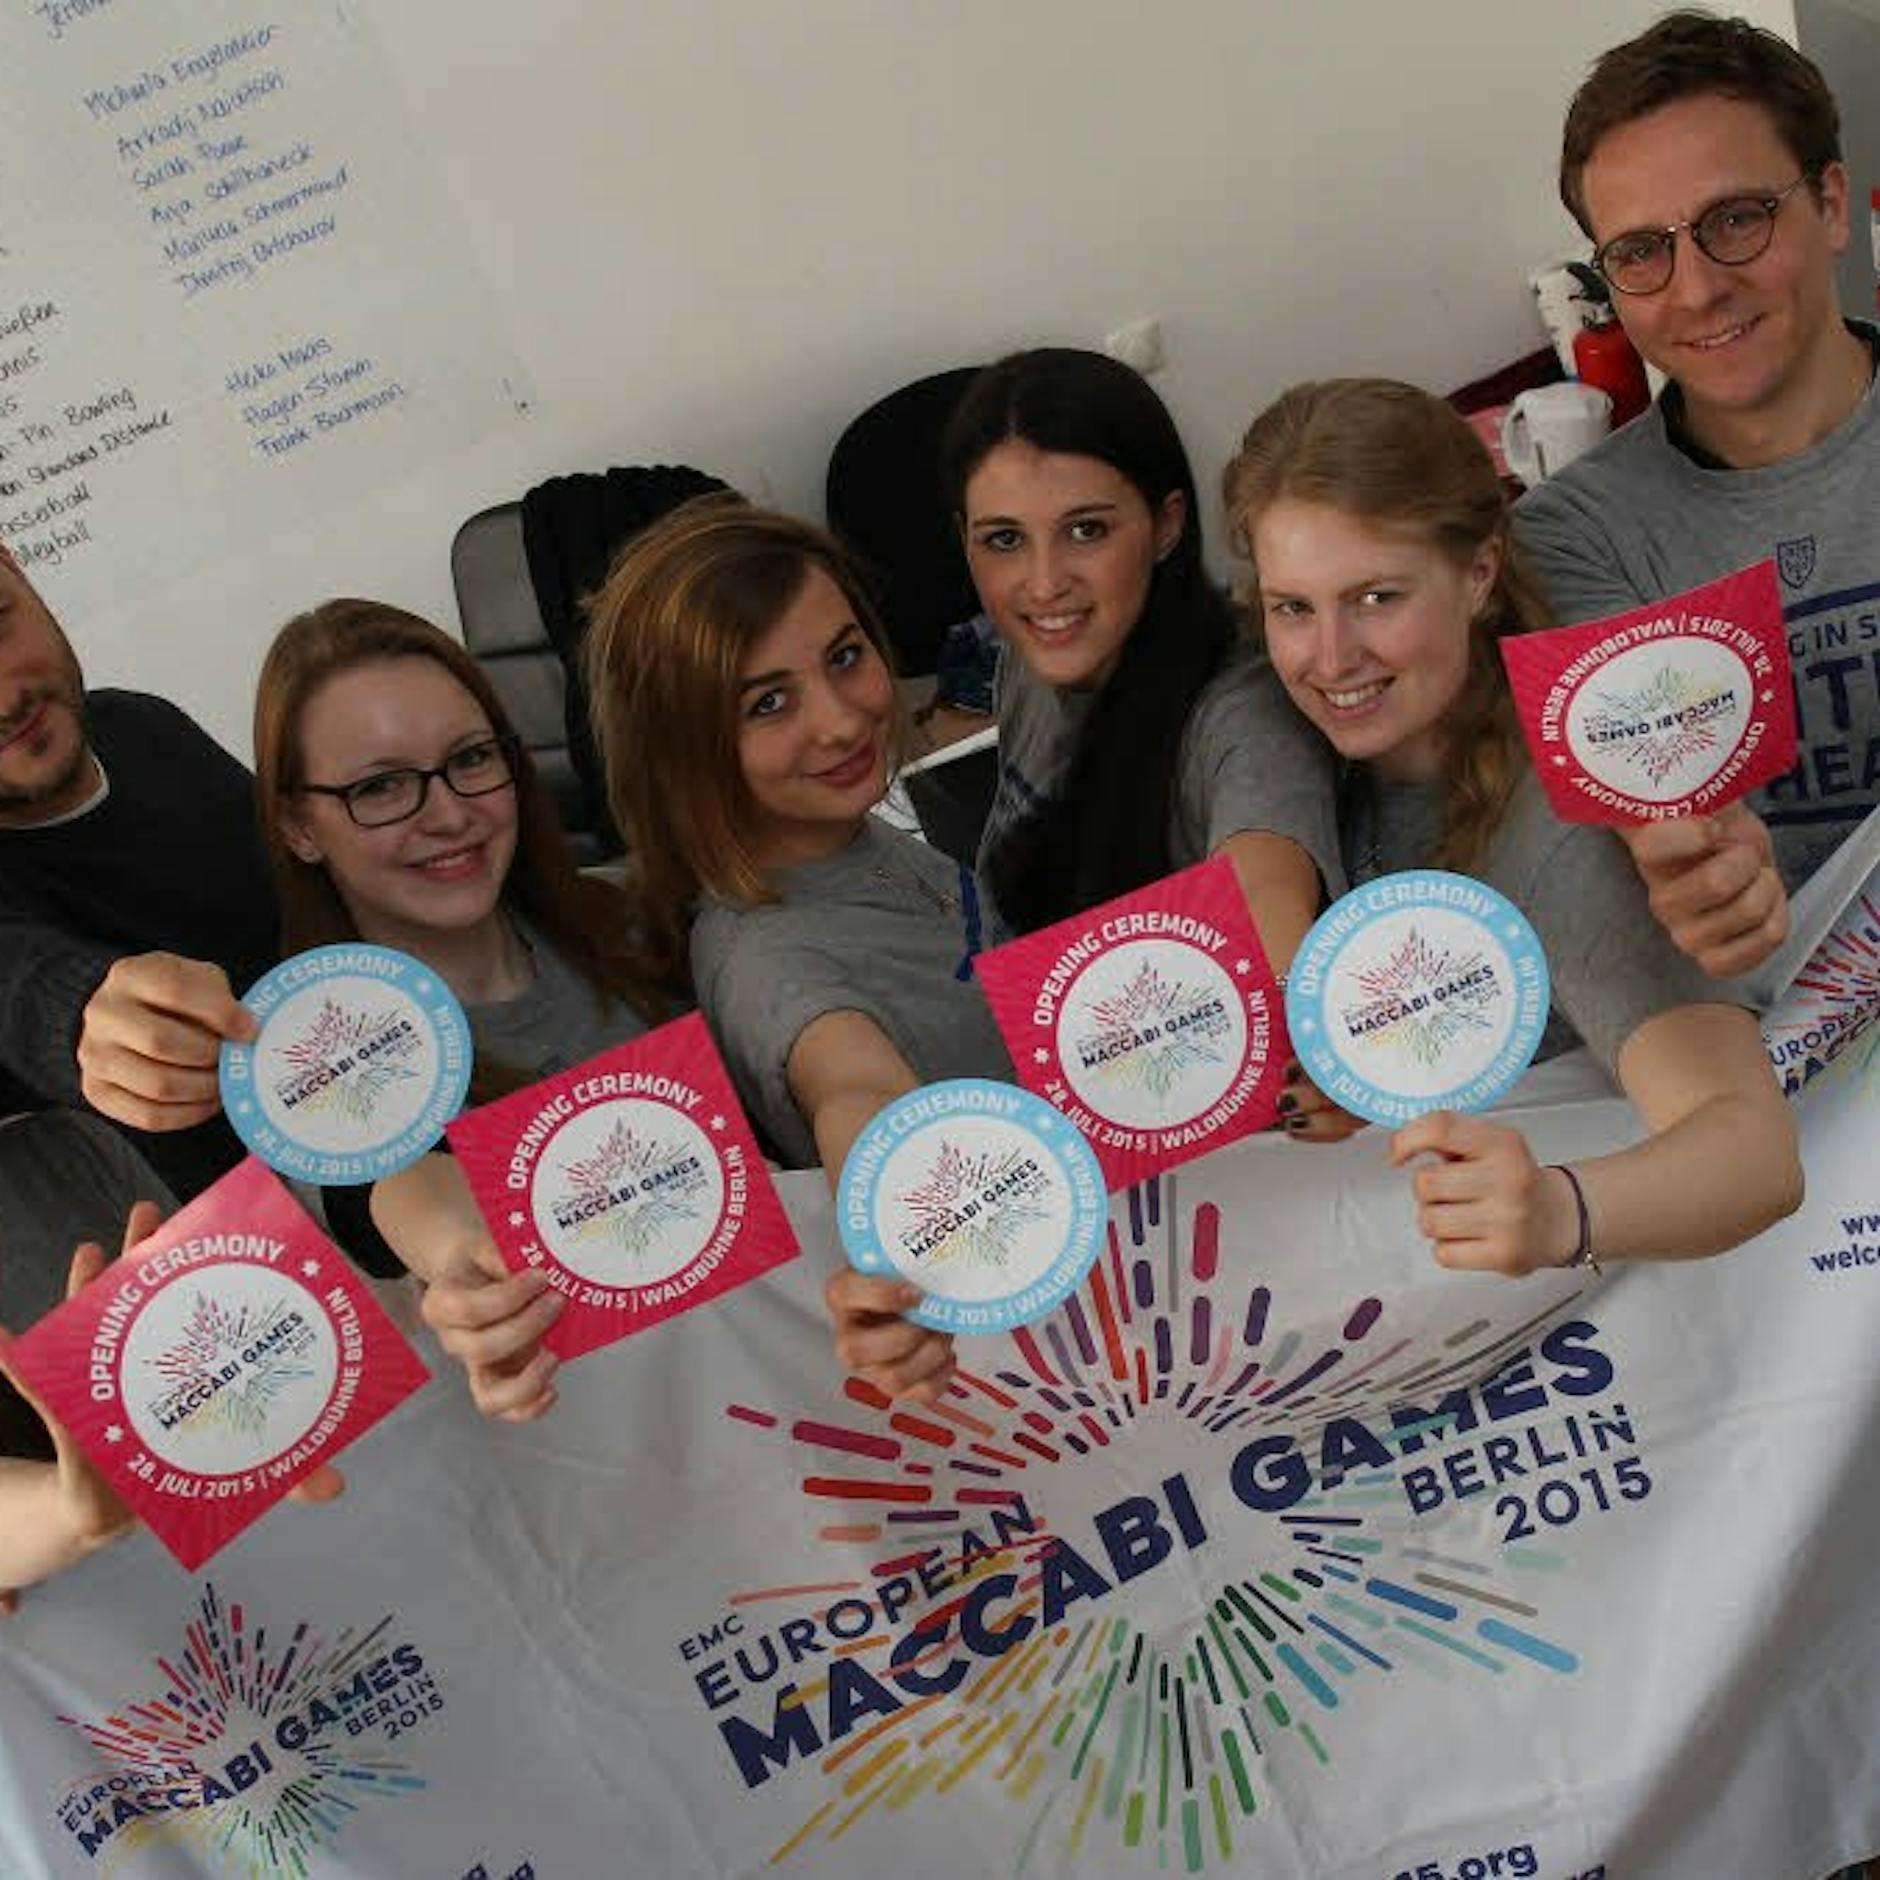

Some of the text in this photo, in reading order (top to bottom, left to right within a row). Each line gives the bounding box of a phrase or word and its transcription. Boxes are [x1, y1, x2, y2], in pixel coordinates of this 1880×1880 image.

[1690, 614, 1732, 636] 2015
[1857, 614, 1880, 641] S
[1541, 685, 1571, 743] BERLIN
[1586, 721, 1650, 744] GAMES
[1656, 689, 1735, 731] MACCABI
[1570, 776, 1695, 821] CEREMONY
[1696, 720, 1767, 801] OPENING
[1033, 911, 1228, 1026] OPENING CEREMONY
[1298, 881, 1500, 996] OPENING CEREMONY
[228, 983, 281, 1081] OPNG
[280, 952, 406, 993] CEREMONY
[1081, 1025, 1161, 1070] MACCABI
[1164, 998, 1226, 1034] GAMES
[1348, 994, 1431, 1039] MACCABI
[1434, 963, 1495, 1002] GAMES
[282, 1056, 356, 1110] MACCABI
[357, 1019, 414, 1061] GAMES
[1101, 1128, 1147, 1152] 2015
[1248, 988, 1271, 1063] BERLIN
[506, 1071, 704, 1190] OPENING CEREMONY
[849, 1130, 893, 1232] OPENING
[889, 1089, 1022, 1134] CEREMONY
[520, 1241, 545, 1269] 28
[579, 1286, 628, 1309] 2015
[724, 1143, 748, 1217] BERLIN
[556, 1184, 639, 1231] MACCABI
[641, 1155, 702, 1193] GAMES
[908, 1197, 982, 1259] MACCABI
[982, 1157, 1040, 1204] GAMES
[1810, 1243, 1880, 1272] welc
[90, 1233, 287, 1401] OPENING CEREMONY
[126, 1452, 156, 1484] 28.
[156, 1470, 202, 1499] JULI
[204, 1475, 256, 1499] 2015
[325, 1284, 363, 1364] BERLIN
[160, 1311, 304, 1432] MACCABI GAMES
[1402, 1403, 1638, 1516] BERLIN
[1495, 1455, 1653, 1543] 2015
[717, 1320, 1614, 1789] MACCABI GAMES
[679, 1614, 746, 1662] EMC
[695, 1493, 1039, 1711] EUROPEAN
[344, 1672, 438, 1738] BERLIN
[382, 1696, 446, 1742] 2015
[76, 1643, 425, 1858] MACCABI GAMES
[64, 1759, 199, 1833] EUROPEAN
